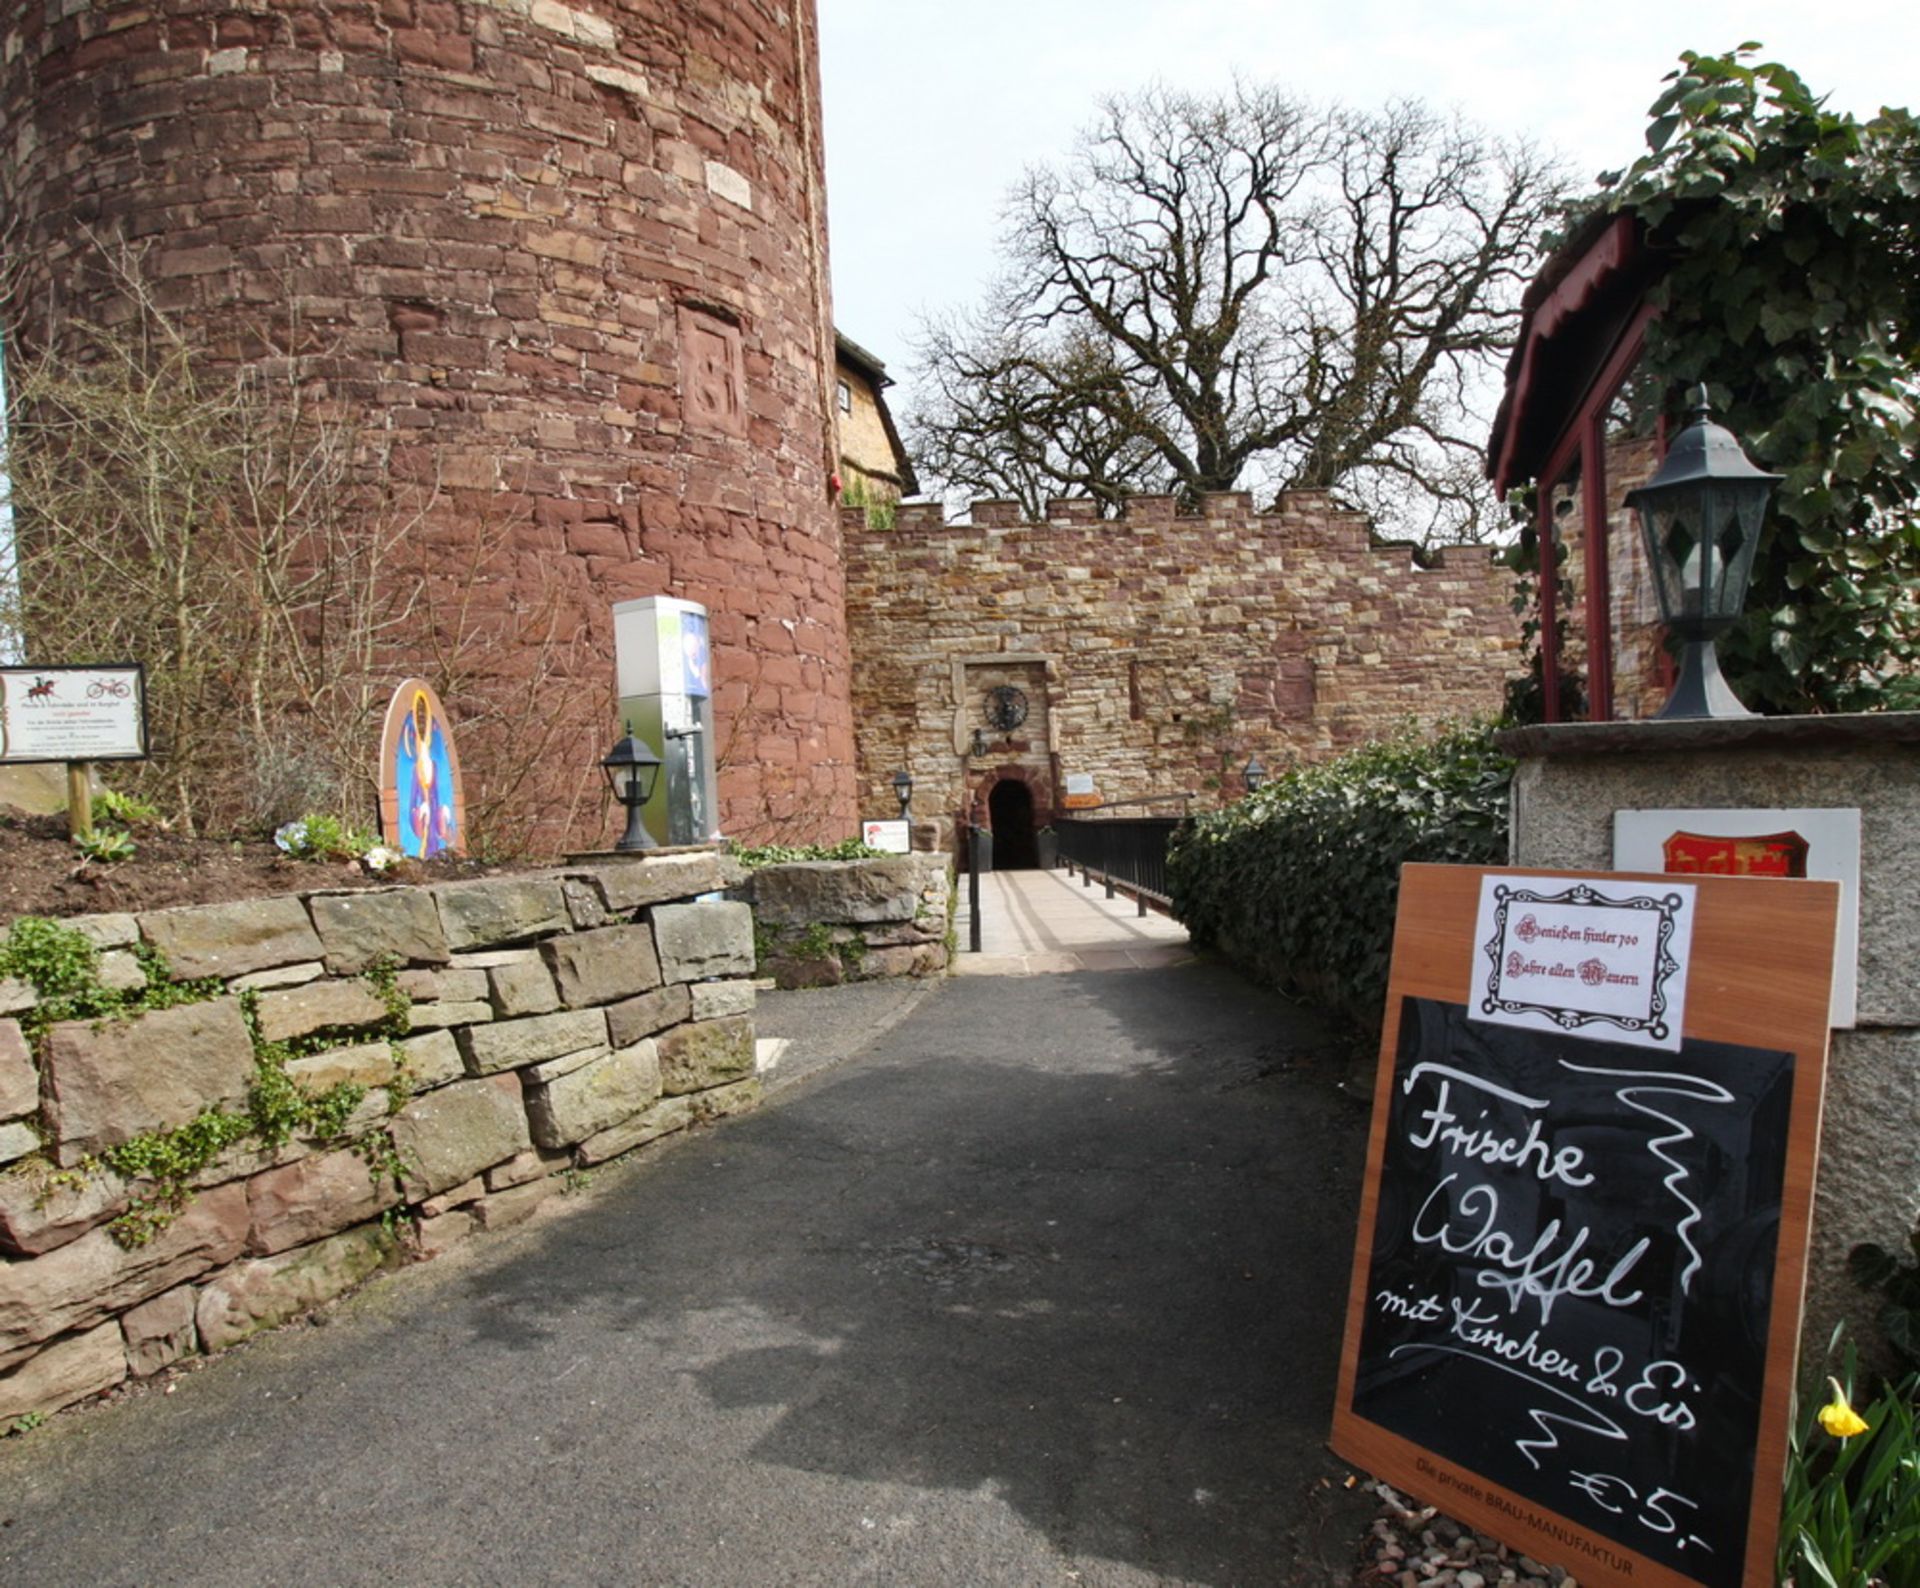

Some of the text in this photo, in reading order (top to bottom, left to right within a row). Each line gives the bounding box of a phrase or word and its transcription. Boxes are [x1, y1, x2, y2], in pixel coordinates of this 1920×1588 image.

[1506, 951, 1639, 986] Jahre alten Mauern
[1617, 933, 1639, 948] 700
[1404, 1062, 1595, 1187] Frische
[1412, 1173, 1651, 1326] Waffel
[1376, 1284, 1701, 1430] mit Kirschen & Eis
[1415, 1457, 1633, 1576] Die private BRAU-MANUFAKTUR
